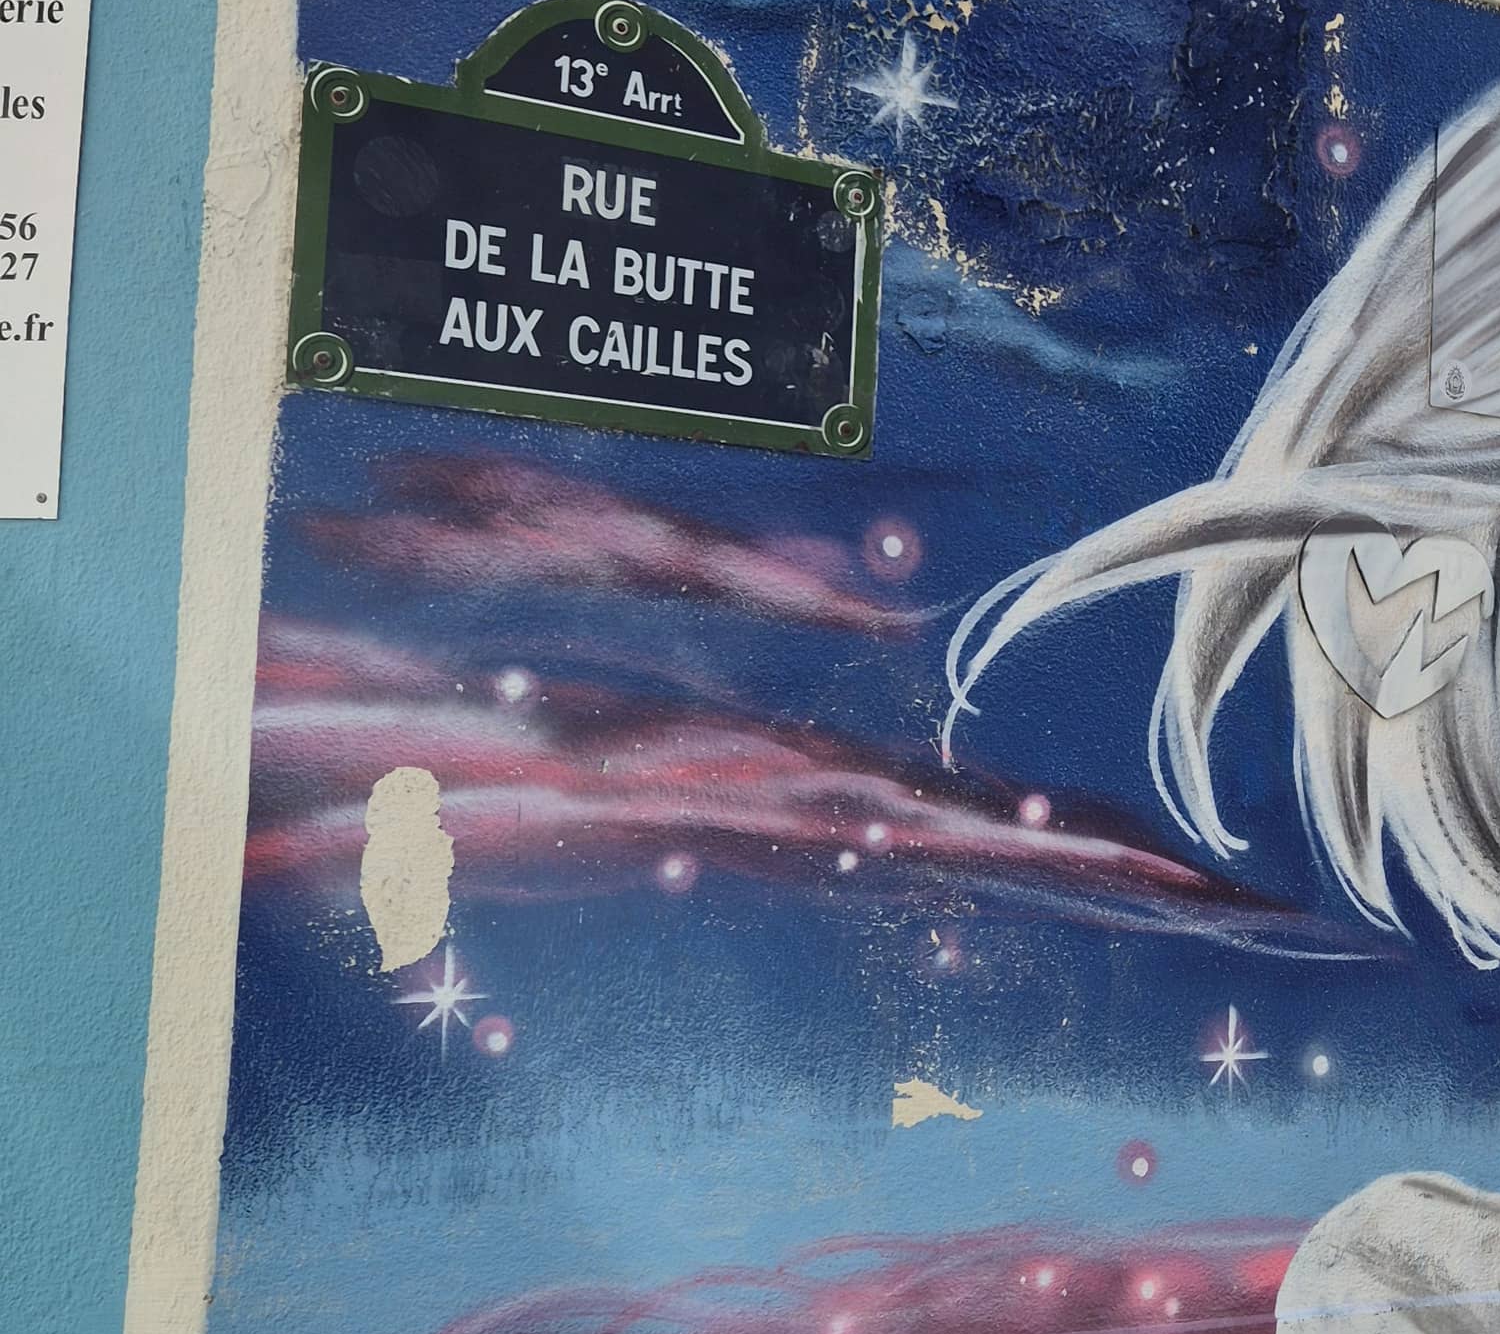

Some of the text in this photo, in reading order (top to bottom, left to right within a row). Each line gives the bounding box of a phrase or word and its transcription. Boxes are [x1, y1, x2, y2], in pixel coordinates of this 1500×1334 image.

[0, 211, 38, 241] 56
[561, 163, 657, 227] RUE
[0, 251, 40, 281] 27
[444, 218, 755, 316] DE LA BUTTE
[439, 297, 753, 387] AUX CAILLES
